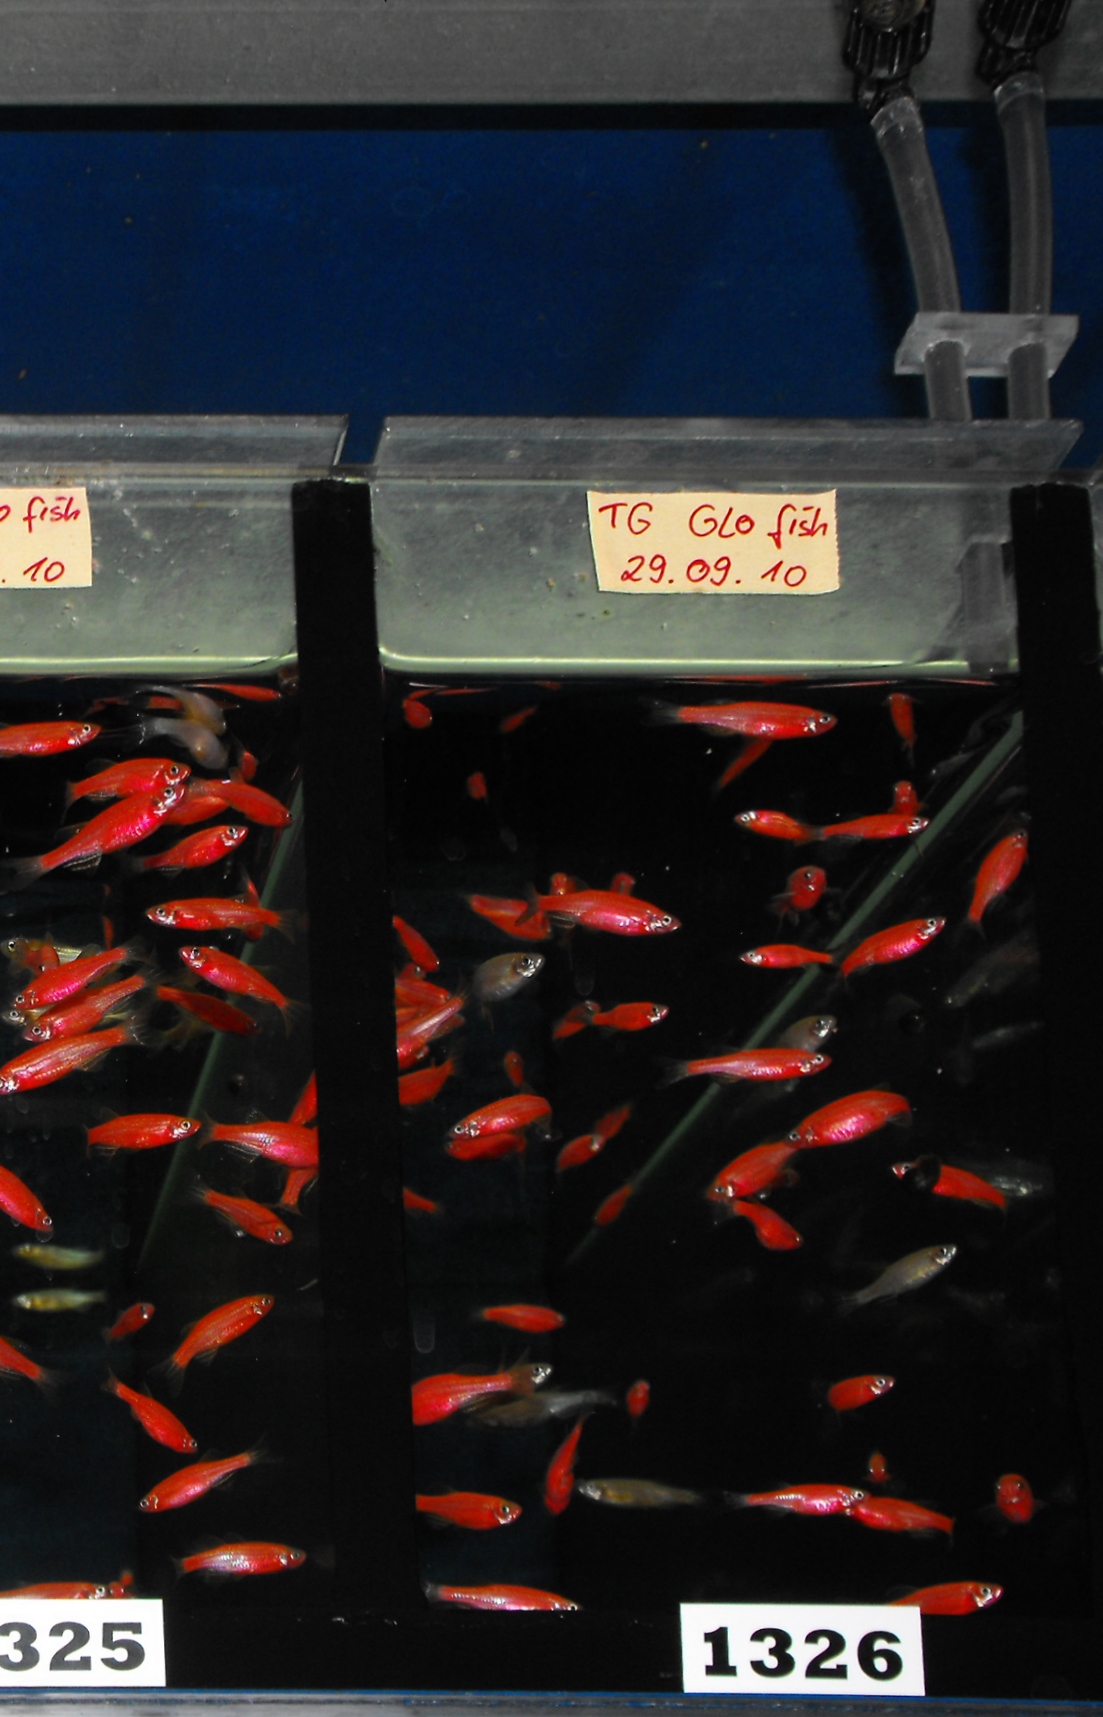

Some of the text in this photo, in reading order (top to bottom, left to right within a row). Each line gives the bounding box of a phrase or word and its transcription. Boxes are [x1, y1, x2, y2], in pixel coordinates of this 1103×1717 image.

[22, 496, 81, 534] fish
[598, 502, 653, 535] TG
[767, 503, 829, 550] fish
[703, 1626, 904, 1682] 1326
